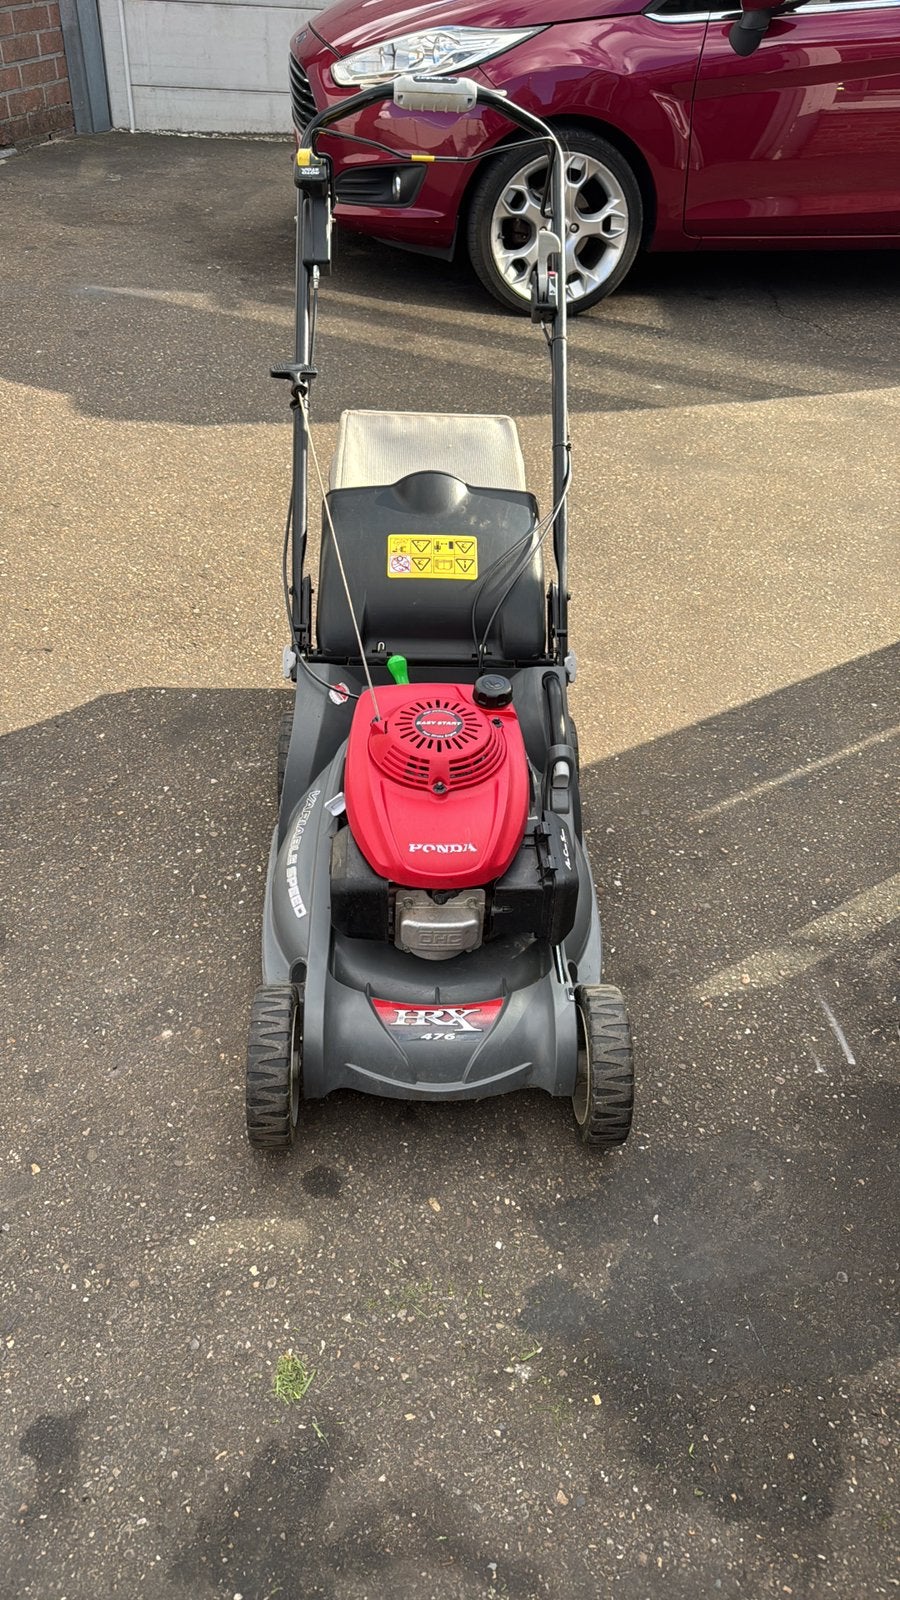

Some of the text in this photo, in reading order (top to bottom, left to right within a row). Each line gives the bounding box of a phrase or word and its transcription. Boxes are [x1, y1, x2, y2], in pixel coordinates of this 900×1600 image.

[286, 790, 321, 919] VARIABLE SPEED
[390, 1008, 482, 1032] HRX
[420, 1032, 456, 1040] 476
